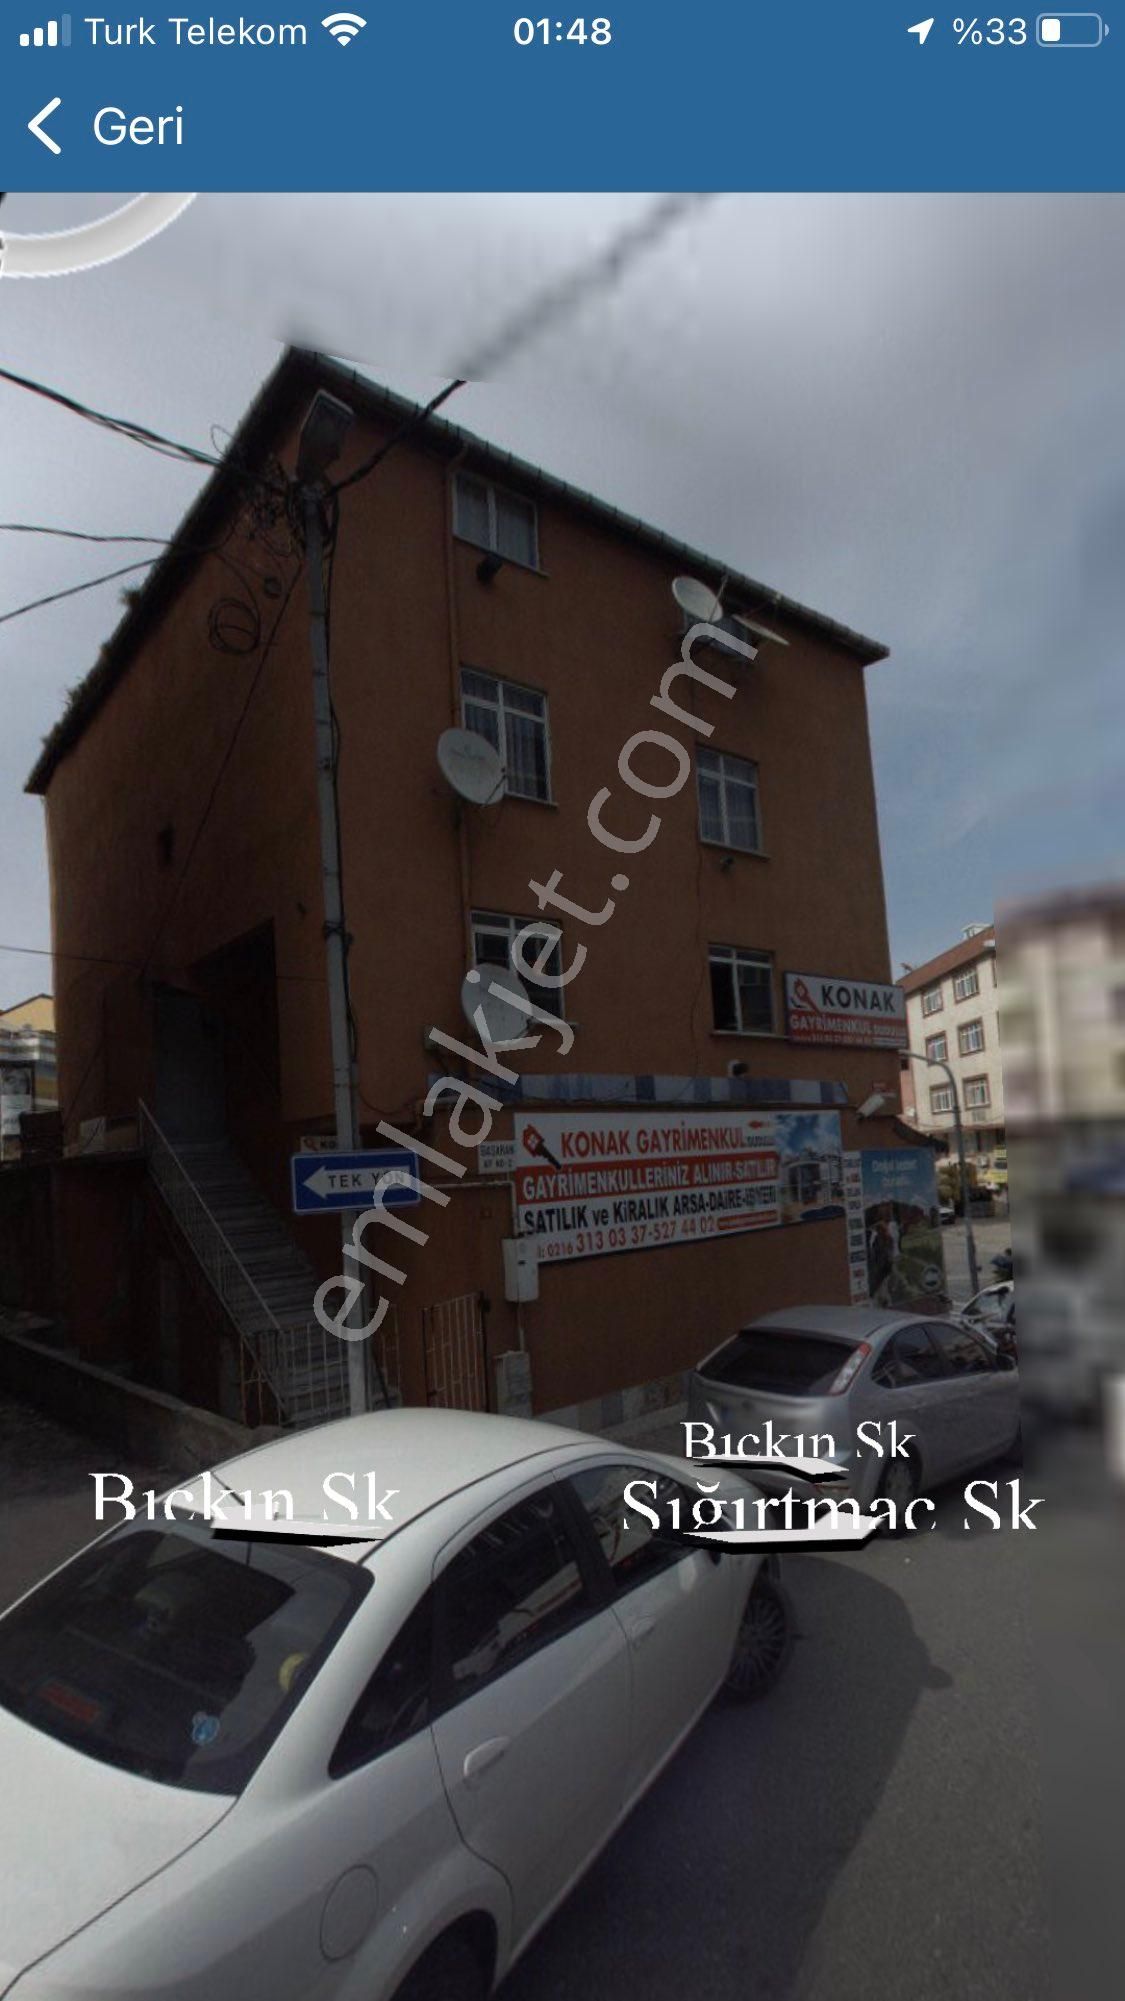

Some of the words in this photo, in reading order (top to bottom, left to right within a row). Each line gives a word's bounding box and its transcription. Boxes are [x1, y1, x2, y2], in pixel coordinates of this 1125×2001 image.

[821, 984, 897, 1013] KONAK
[560, 1129, 631, 1159] KONAK
[636, 1120, 747, 1155] GAYRİMENKUL
[327, 1173, 363, 1189] TEK
[522, 1160, 690, 1201] GAYRİMENKULLERİNİZ
[524, 1204, 588, 1236] SATILIK
[591, 1207, 609, 1227] ve
[546, 1242, 574, 1258] 0216
[576, 1231, 605, 1254] 313
[608, 1228, 627, 1249] 03
[631, 1221, 677, 1245] 37-527
[680, 1218, 697, 1235] 44
